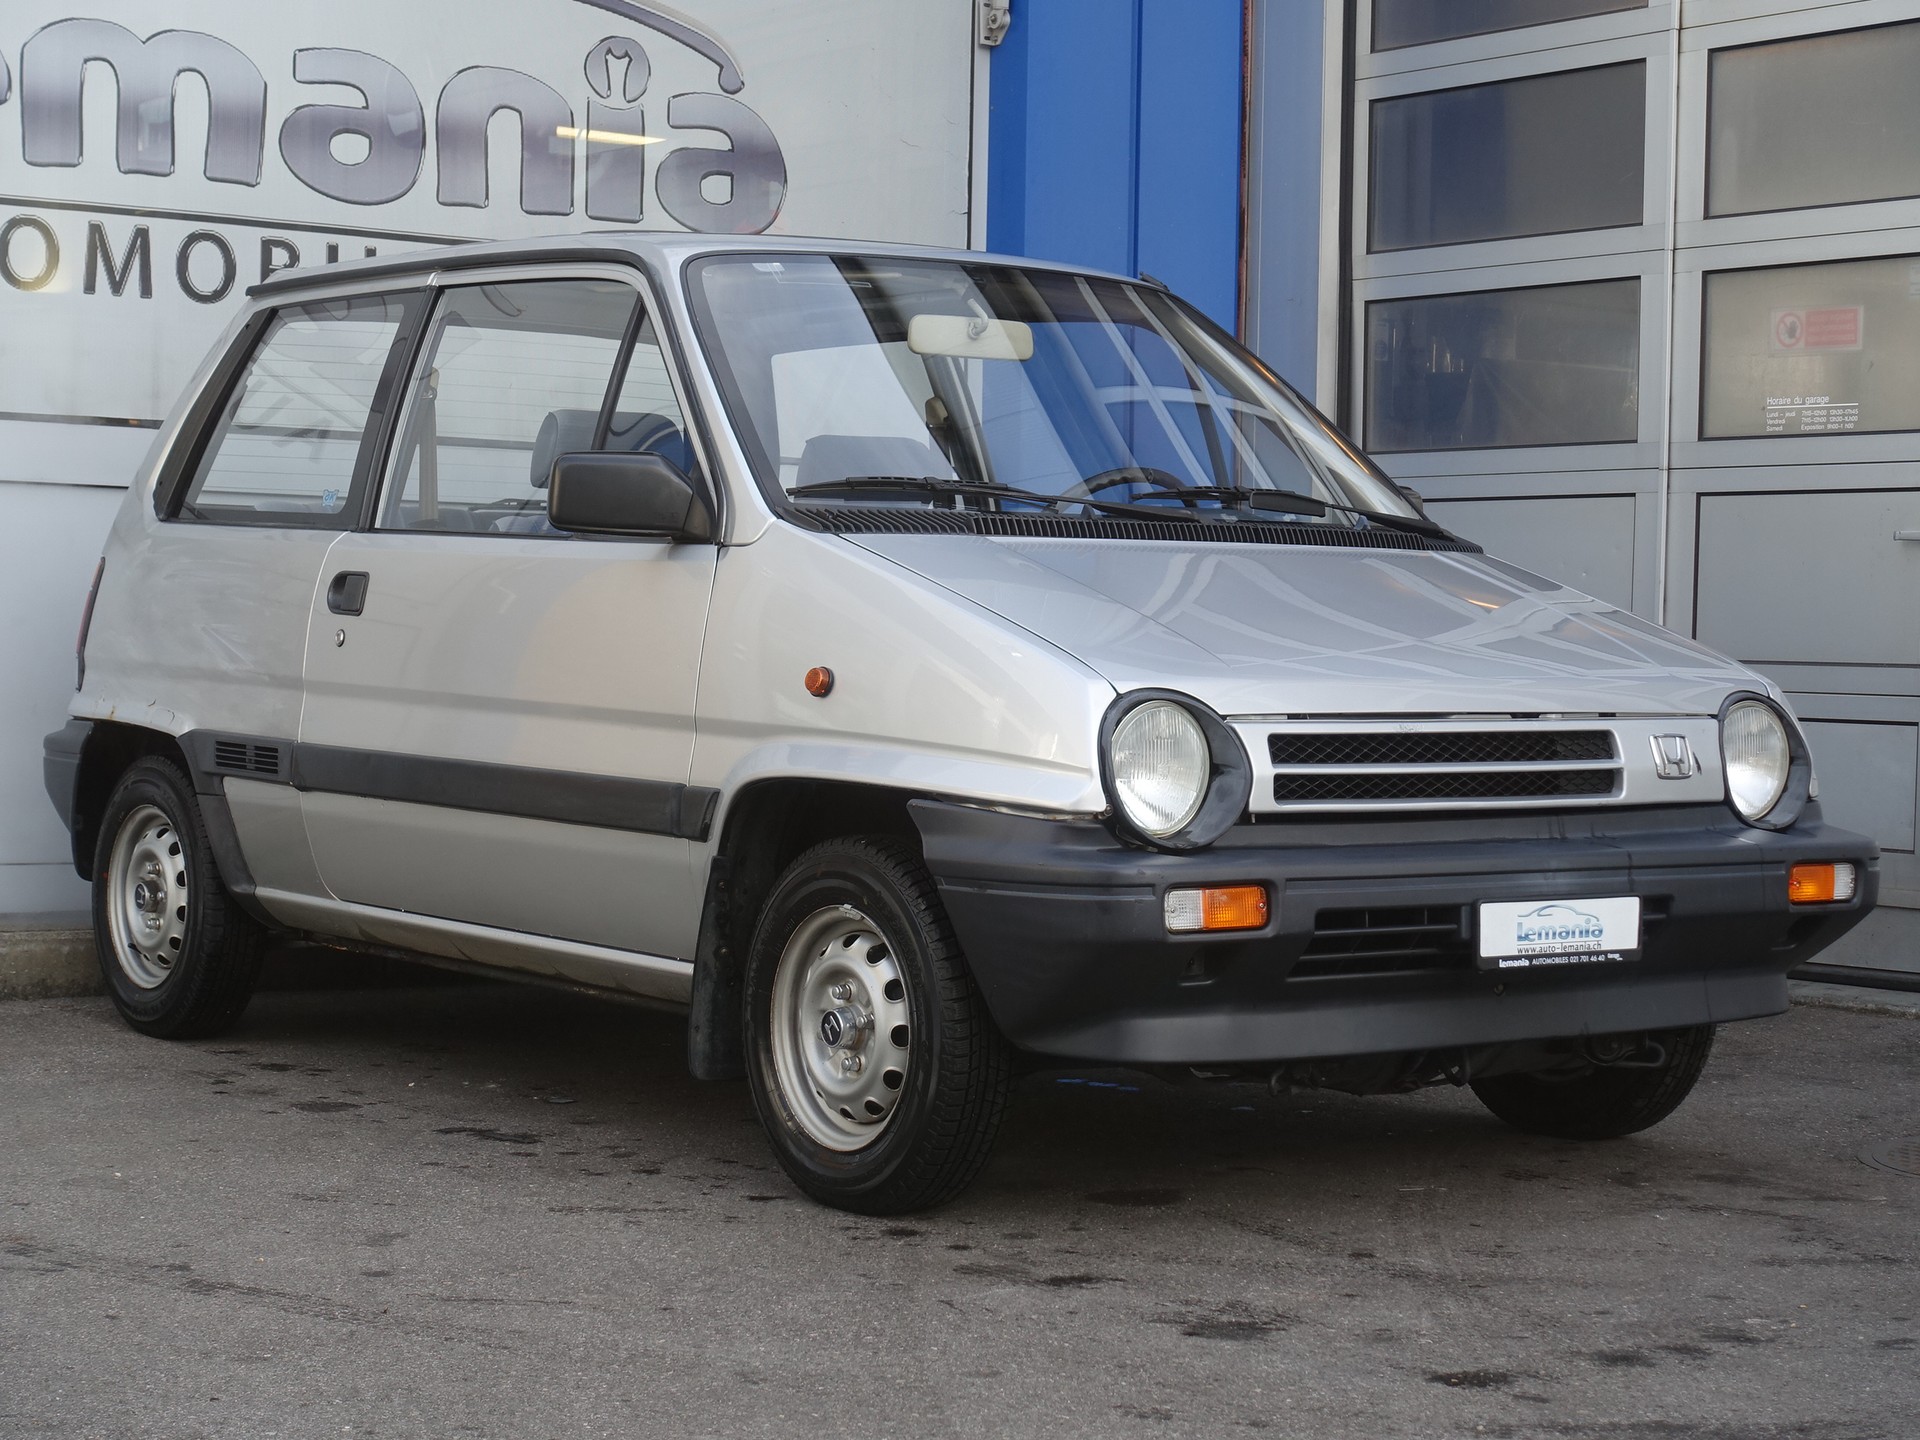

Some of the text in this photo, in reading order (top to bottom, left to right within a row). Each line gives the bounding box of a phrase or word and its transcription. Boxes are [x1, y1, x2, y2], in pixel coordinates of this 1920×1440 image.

[0, 17, 788, 235] mania
[0, 213, 377, 304] OMOB
[1766, 395, 1830, 406] Horaire du garage
[1800, 423, 1825, 432] Exposition
[1517, 917, 1603, 942] Lemania
[1517, 941, 1602, 954] www.auto-lemania.ch
[1532, 956, 1569, 965] AUTOMOBILES
